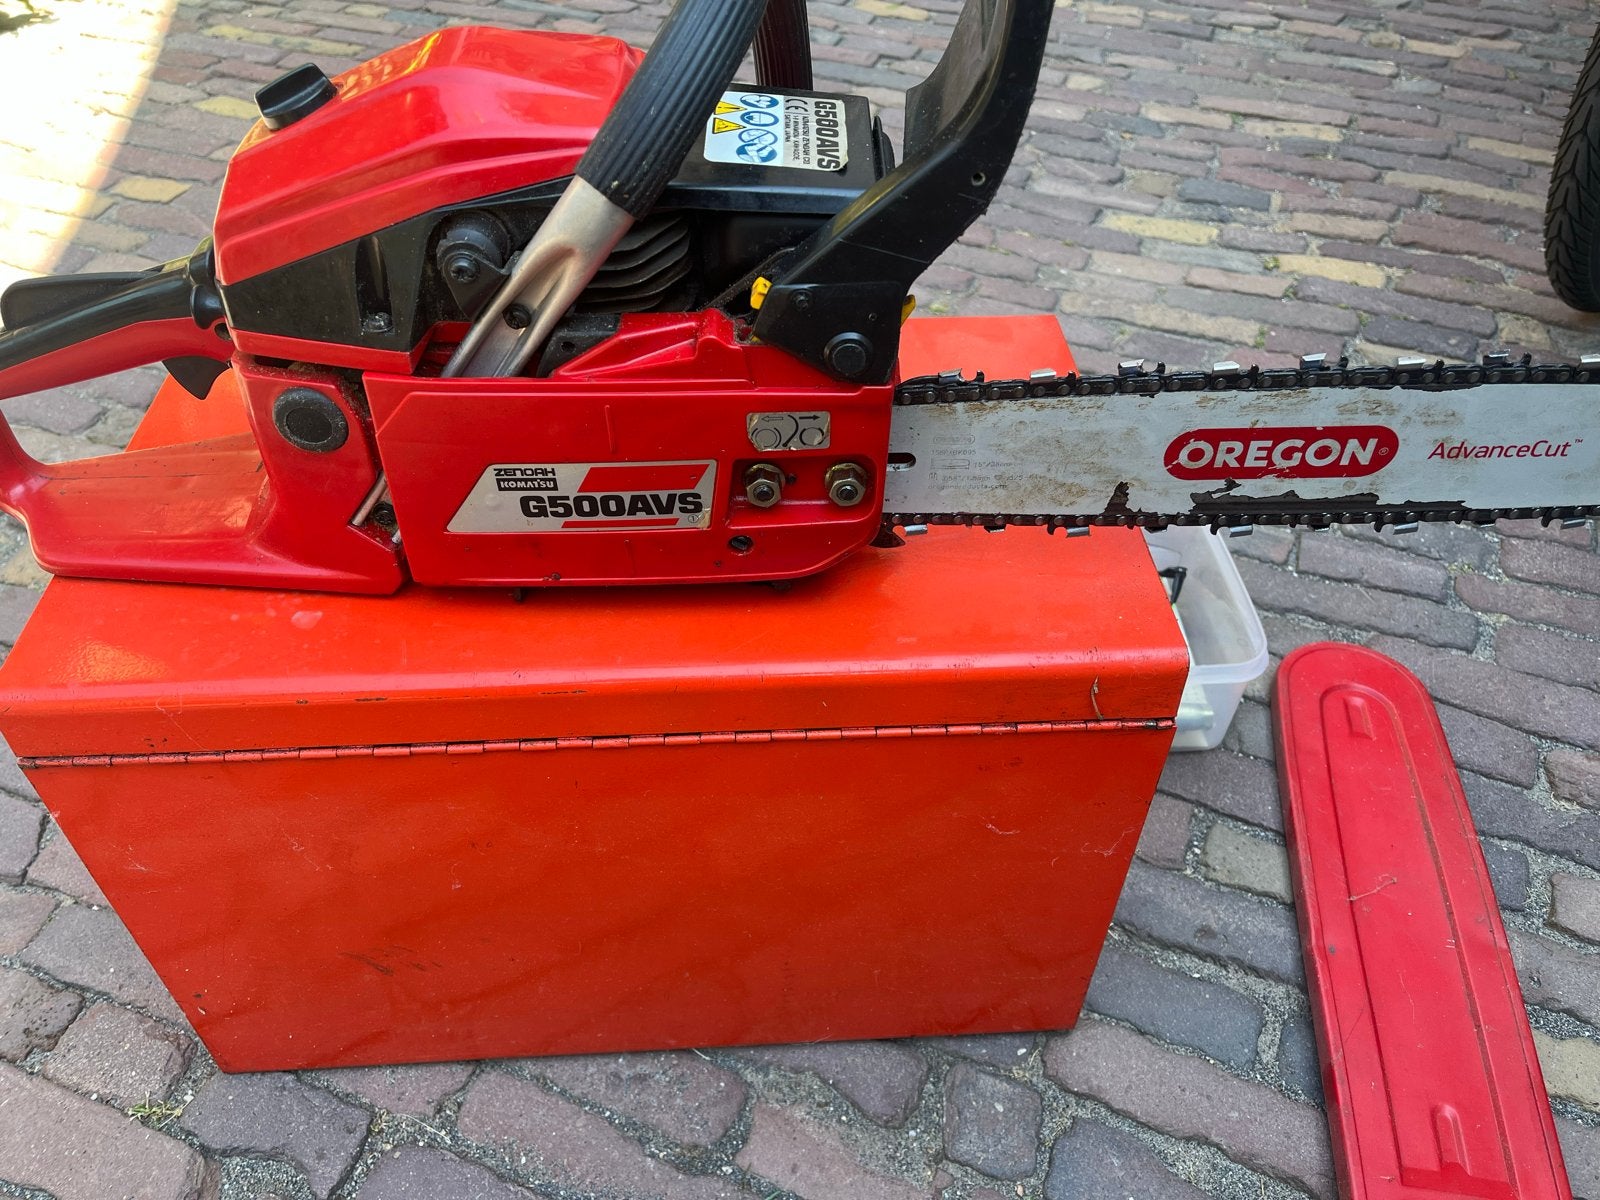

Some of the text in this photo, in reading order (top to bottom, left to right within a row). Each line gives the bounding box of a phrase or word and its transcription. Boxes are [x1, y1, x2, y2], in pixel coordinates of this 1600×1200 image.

[493, 467, 556, 477] ZENOAH
[499, 478, 554, 489] KOMATSU
[519, 492, 703, 518] G500AVS
